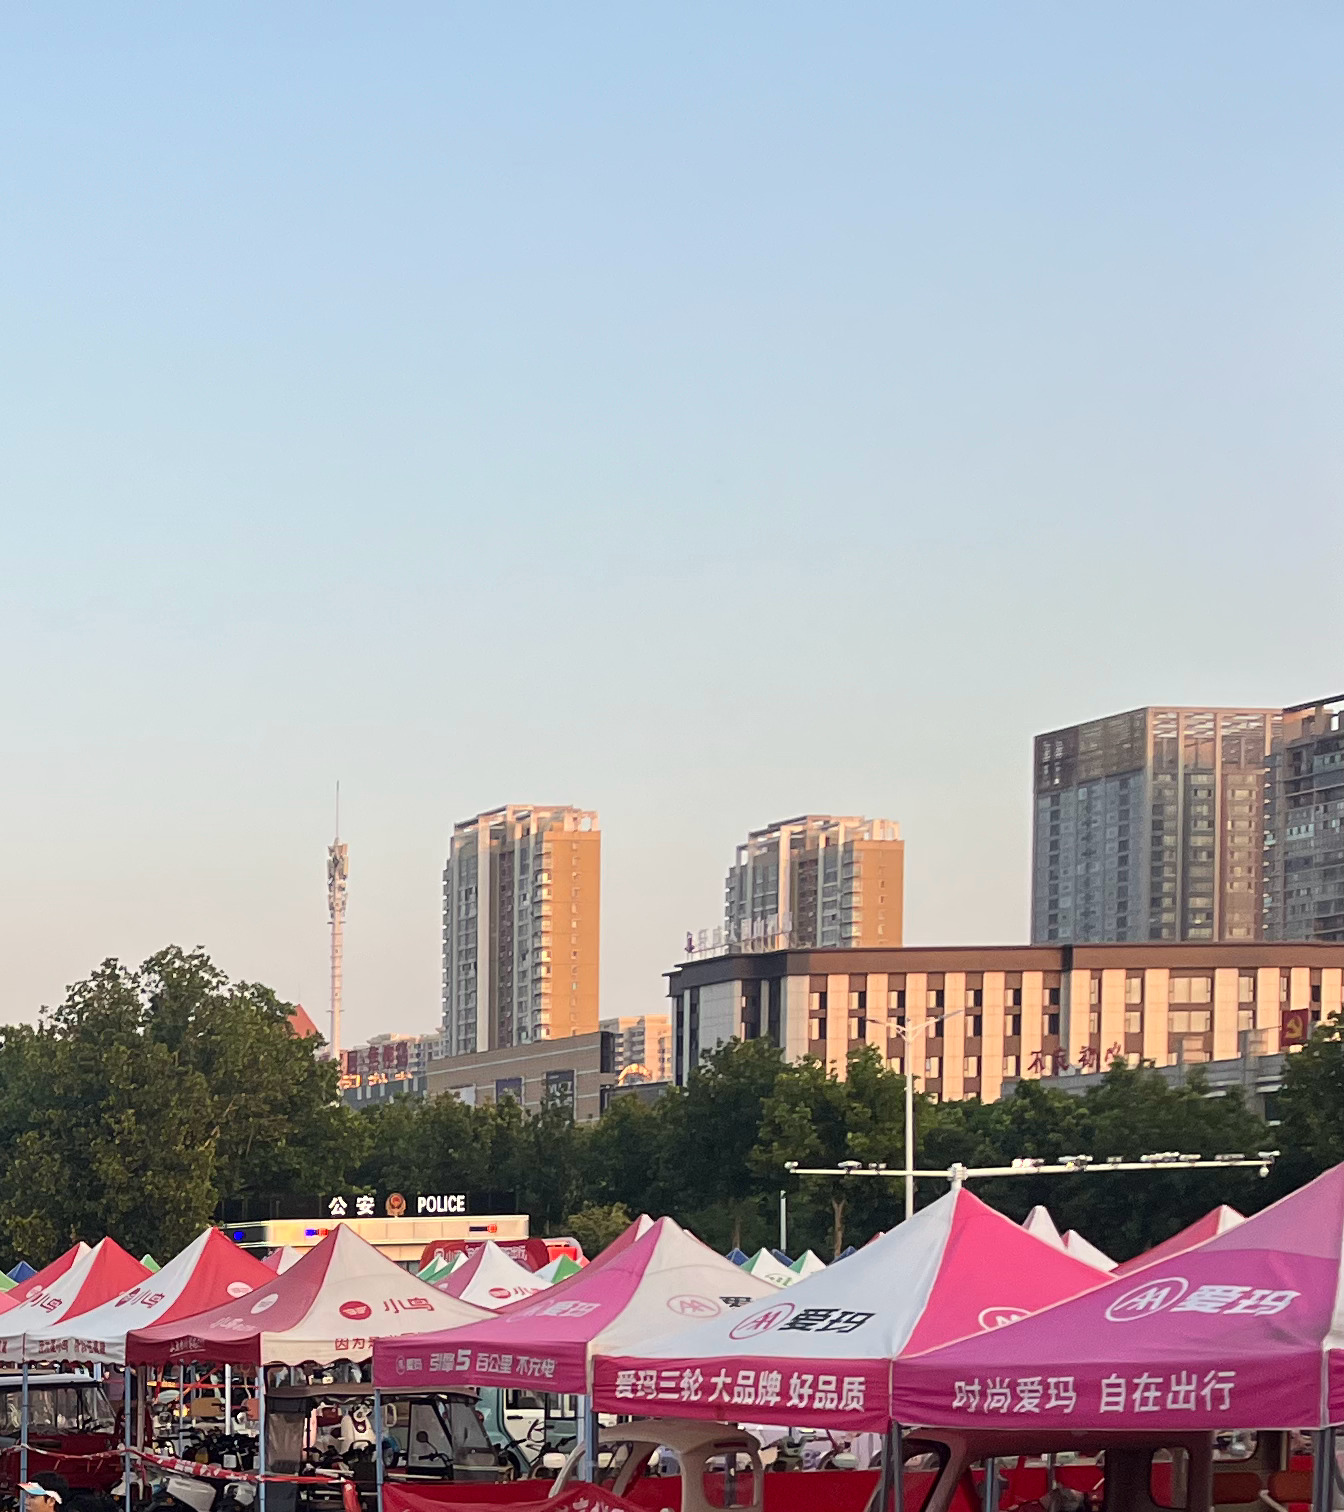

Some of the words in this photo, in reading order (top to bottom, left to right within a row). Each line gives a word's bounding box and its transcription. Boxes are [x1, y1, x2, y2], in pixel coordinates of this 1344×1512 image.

[328, 1195, 375, 1216] 公安
[417, 1195, 466, 1213] POLICE
[383, 1297, 435, 1314] 小鸟
[1170, 1284, 1302, 1317] 爱玛
[778, 1308, 876, 1334] 爱玛
[515, 1355, 556, 1378] 不充电
[615, 1369, 703, 1400] 爱玛三轮
[708, 1368, 782, 1407] 大品牌
[786, 1371, 866, 1412] 好品质
[952, 1376, 1077, 1414] 时尚爱玛
[1098, 1370, 1236, 1413] 自在出行
